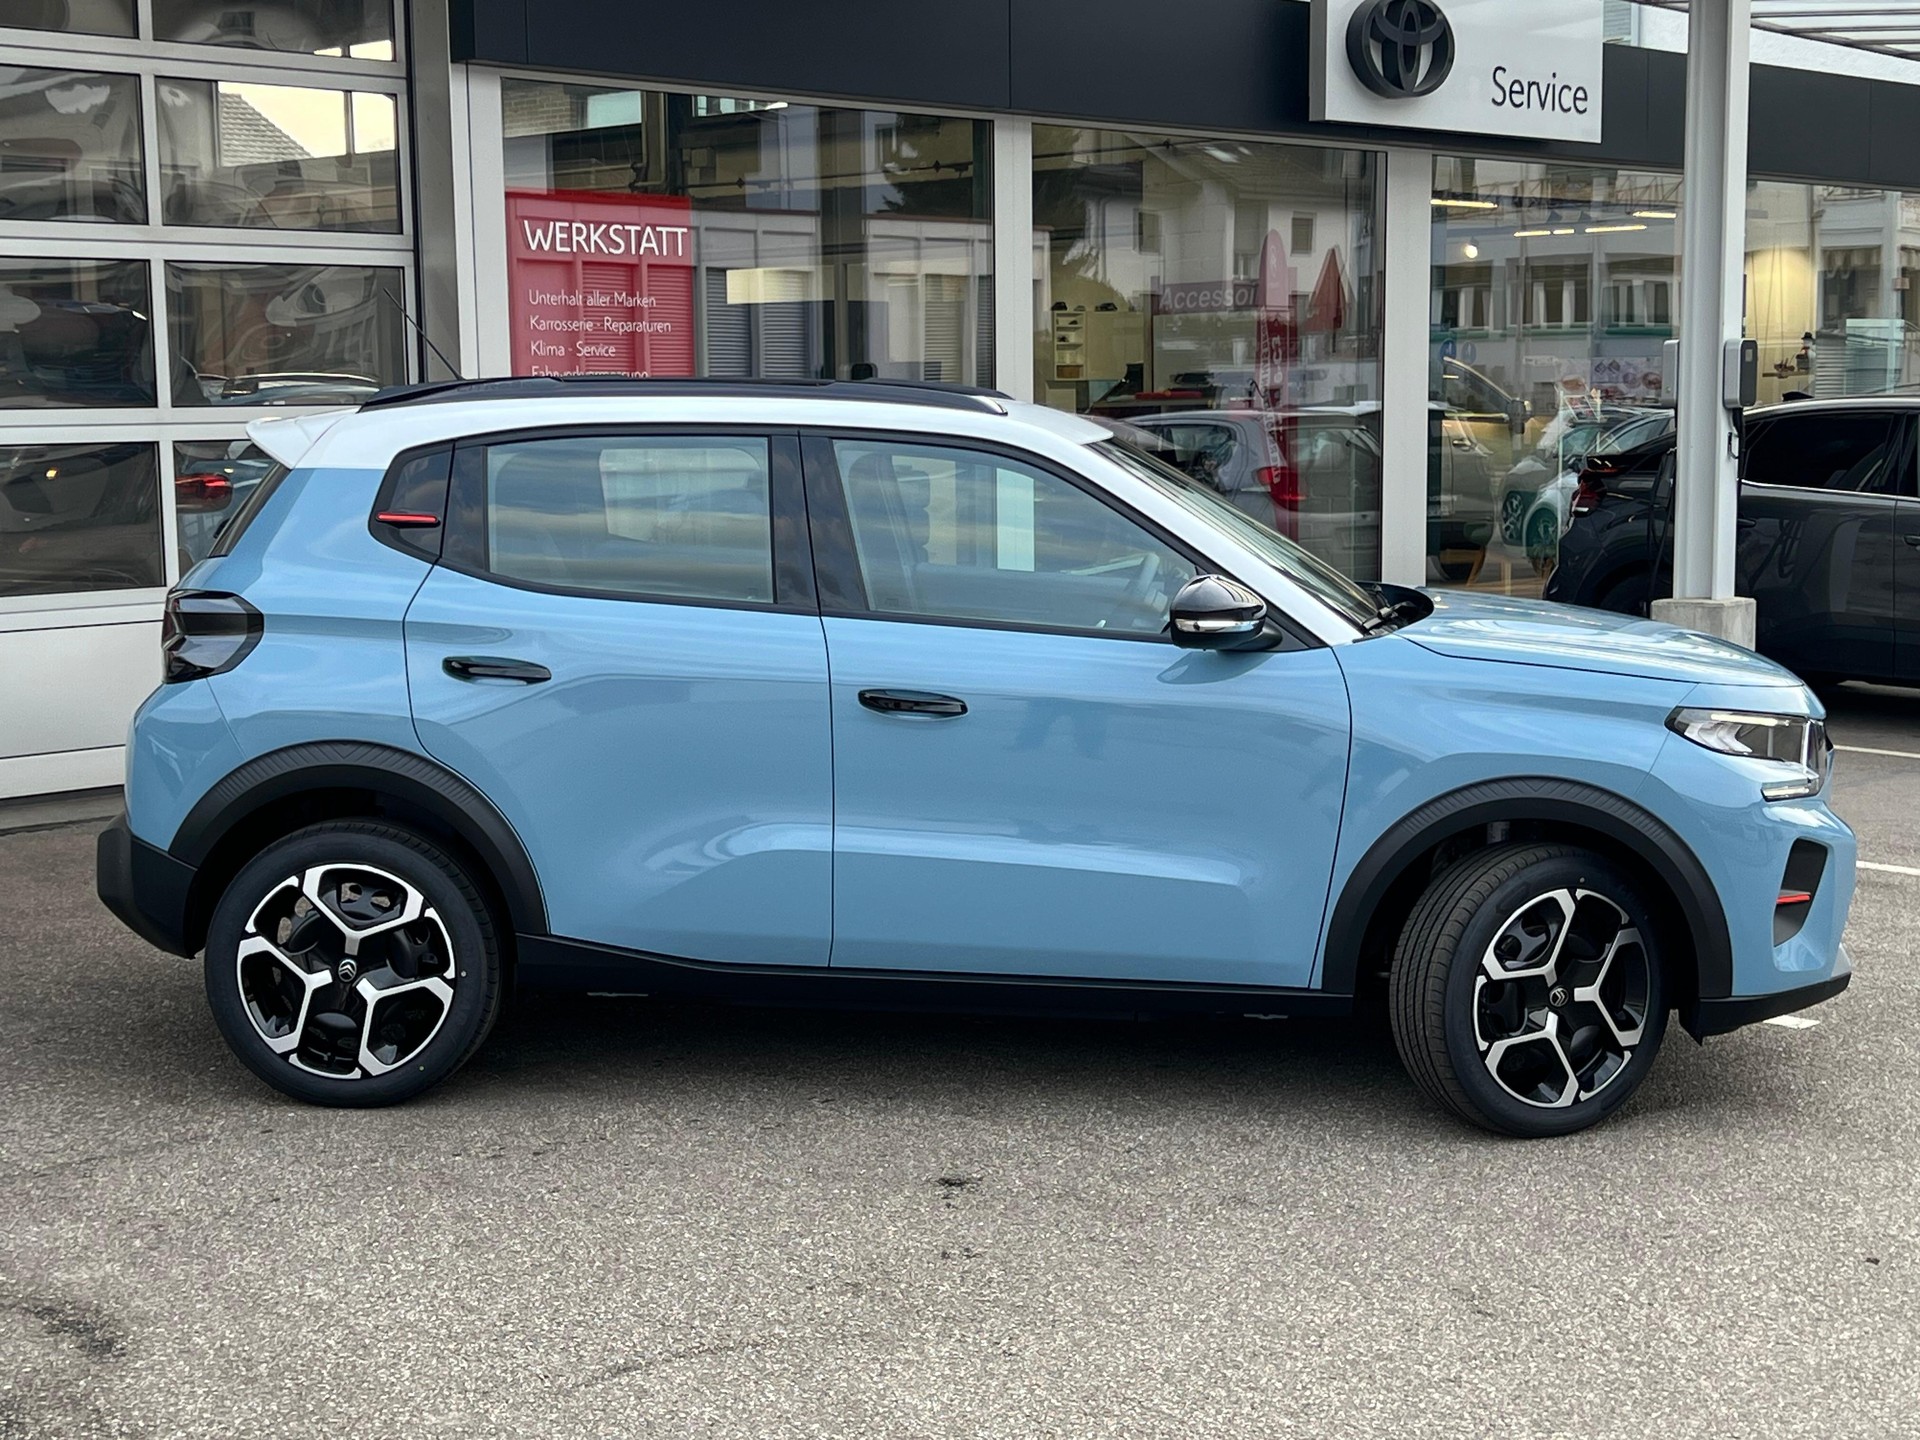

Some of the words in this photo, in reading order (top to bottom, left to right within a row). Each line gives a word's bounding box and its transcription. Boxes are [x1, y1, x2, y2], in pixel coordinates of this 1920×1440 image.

[1491, 66, 1588, 114] Service
[523, 219, 688, 257] WERKSTATT
[528, 288, 583, 306] Unterhalt
[586, 289, 610, 307] aller
[613, 291, 656, 308] Marken
[529, 314, 594, 332] Karrosserie
[604, 316, 672, 336] Reparaturen
[530, 340, 566, 357] Klima
[576, 340, 616, 357] Service
